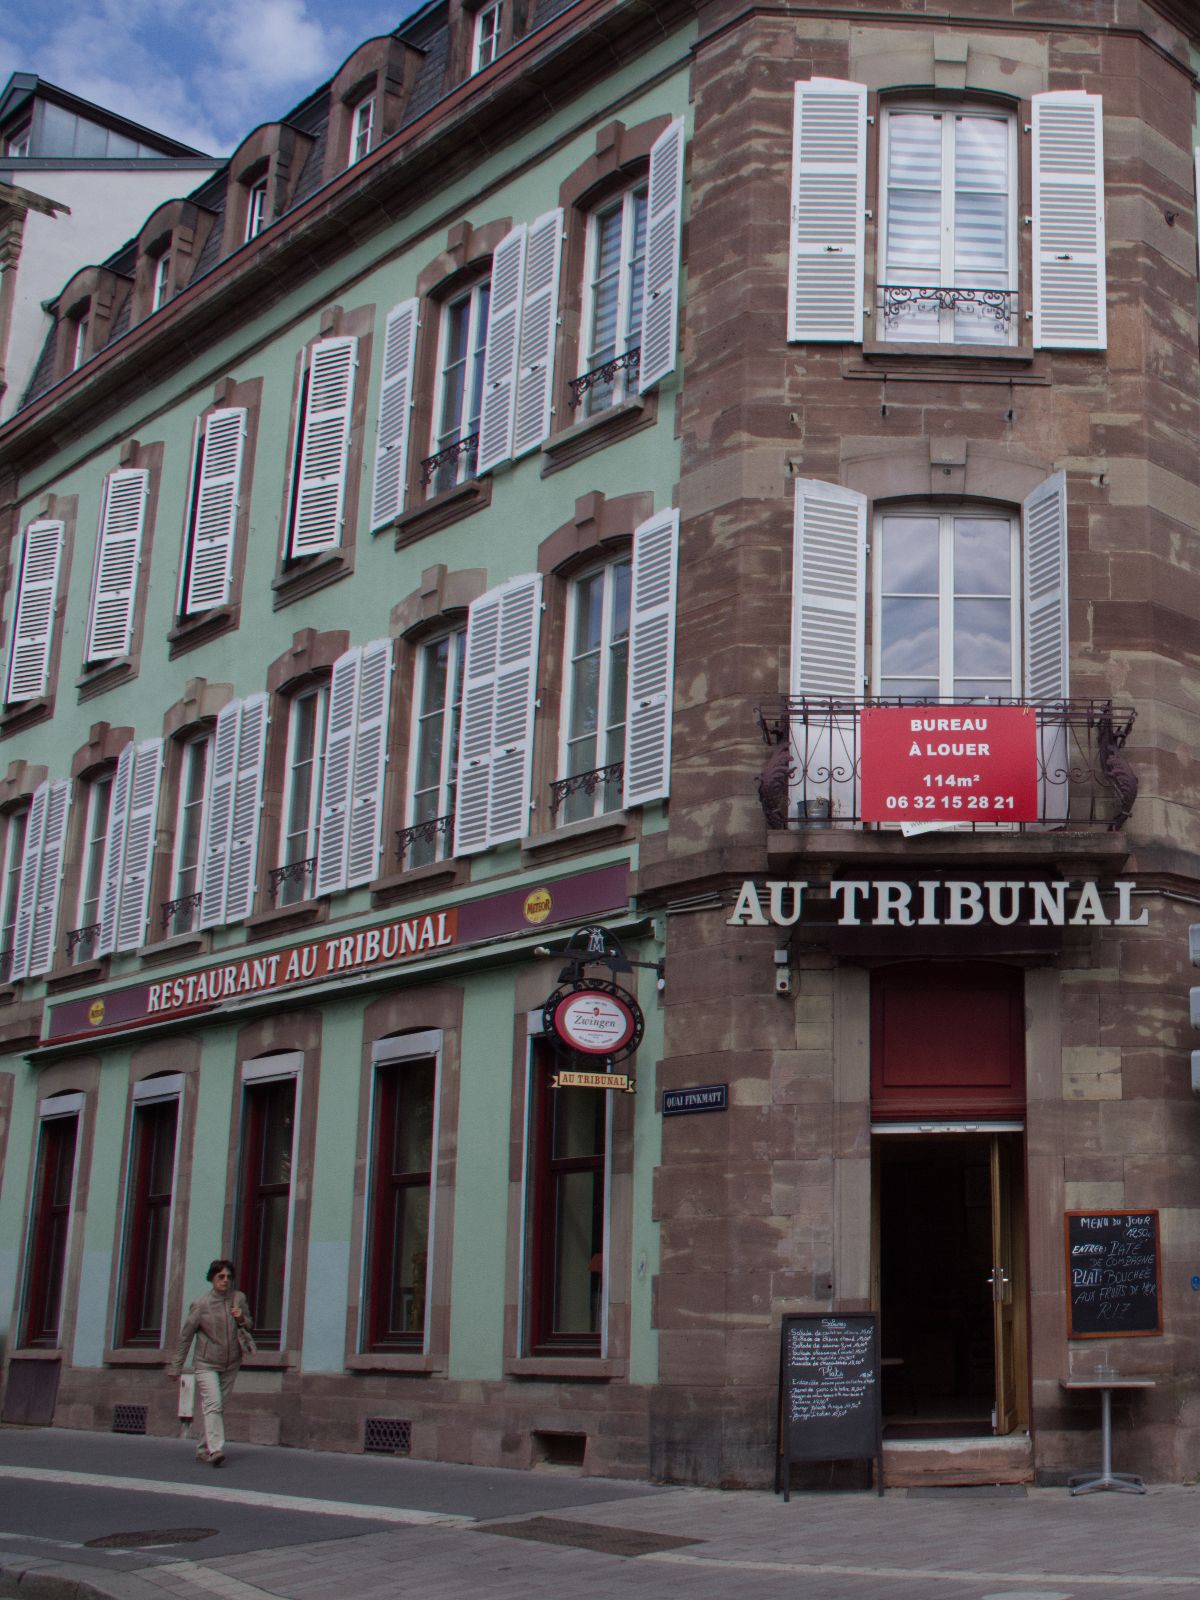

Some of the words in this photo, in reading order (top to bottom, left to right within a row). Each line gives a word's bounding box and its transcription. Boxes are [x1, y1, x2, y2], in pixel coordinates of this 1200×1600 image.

[910, 718, 988, 732] BUREAU
[909, 741, 922, 756] À
[926, 743, 991, 756] LOUER
[923, 774, 980, 787] 114m²
[885, 795, 909, 809] 06
[913, 795, 936, 809] 32
[940, 795, 963, 809] 15
[967, 795, 989, 809] 28
[993, 795, 1015, 809] 21
[726, 880, 808, 927] AU
[830, 880, 1149, 927] TRIBUNAL
[147, 954, 282, 1013] RESTAURANT
[285, 944, 317, 981] AU
[325, 911, 453, 971] TRIBUNAL
[574, 1015, 616, 1029] Zwingen
[562, 1073, 575, 1083] AU
[577, 1074, 626, 1086] TRIBUNAL
[666, 1096, 684, 1108] QUAI
[1080, 1217, 1109, 1229] MENU
[1125, 1215, 1151, 1228] JOUR
[1074, 1290, 1096, 1305] AUX
